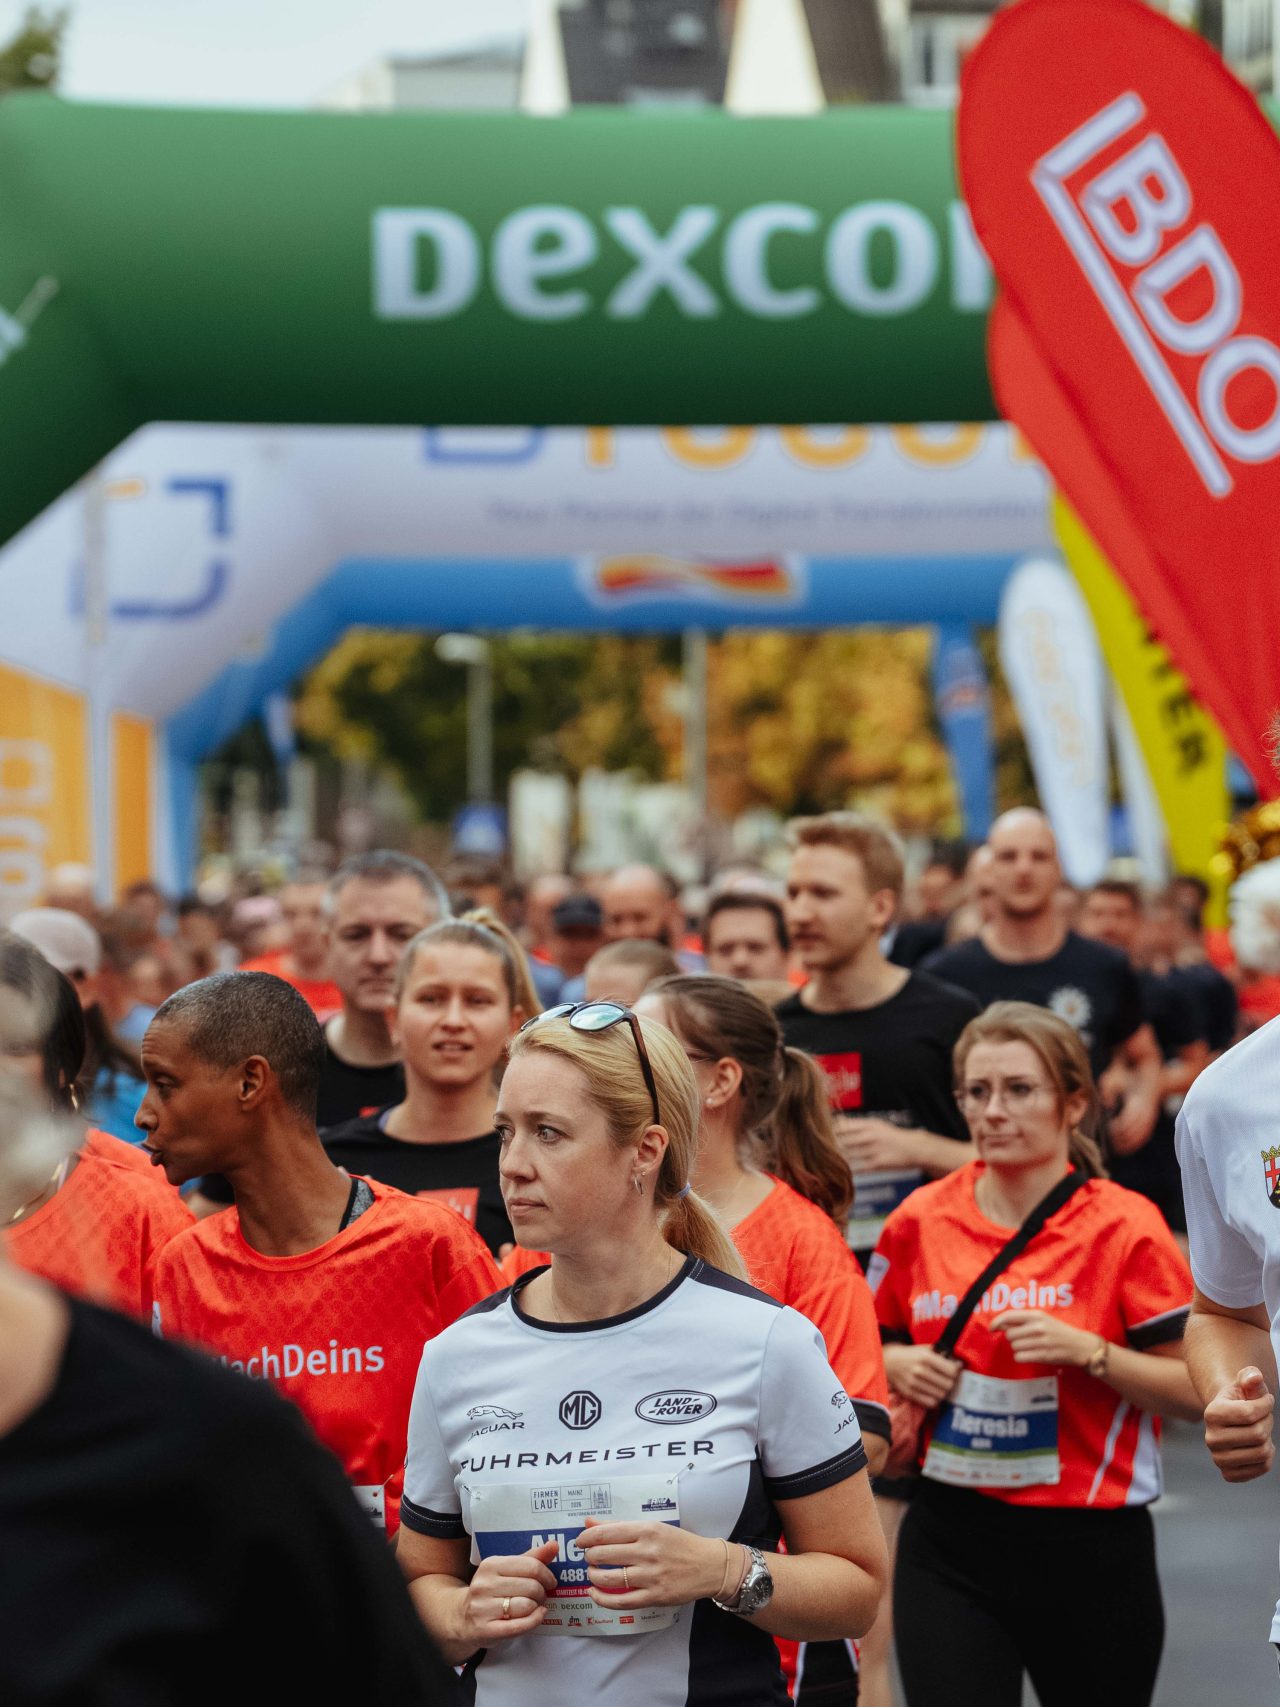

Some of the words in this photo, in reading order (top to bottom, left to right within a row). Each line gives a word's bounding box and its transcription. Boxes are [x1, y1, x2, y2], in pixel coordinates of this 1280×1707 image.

[562, 1393, 599, 1428] MG
[467, 1420, 526, 1442] JAGUAR
[460, 1440, 716, 1473] FUHRMEISTER
[533, 1489, 559, 1498] FIRMEN
[534, 1498, 559, 1510] LAUF
